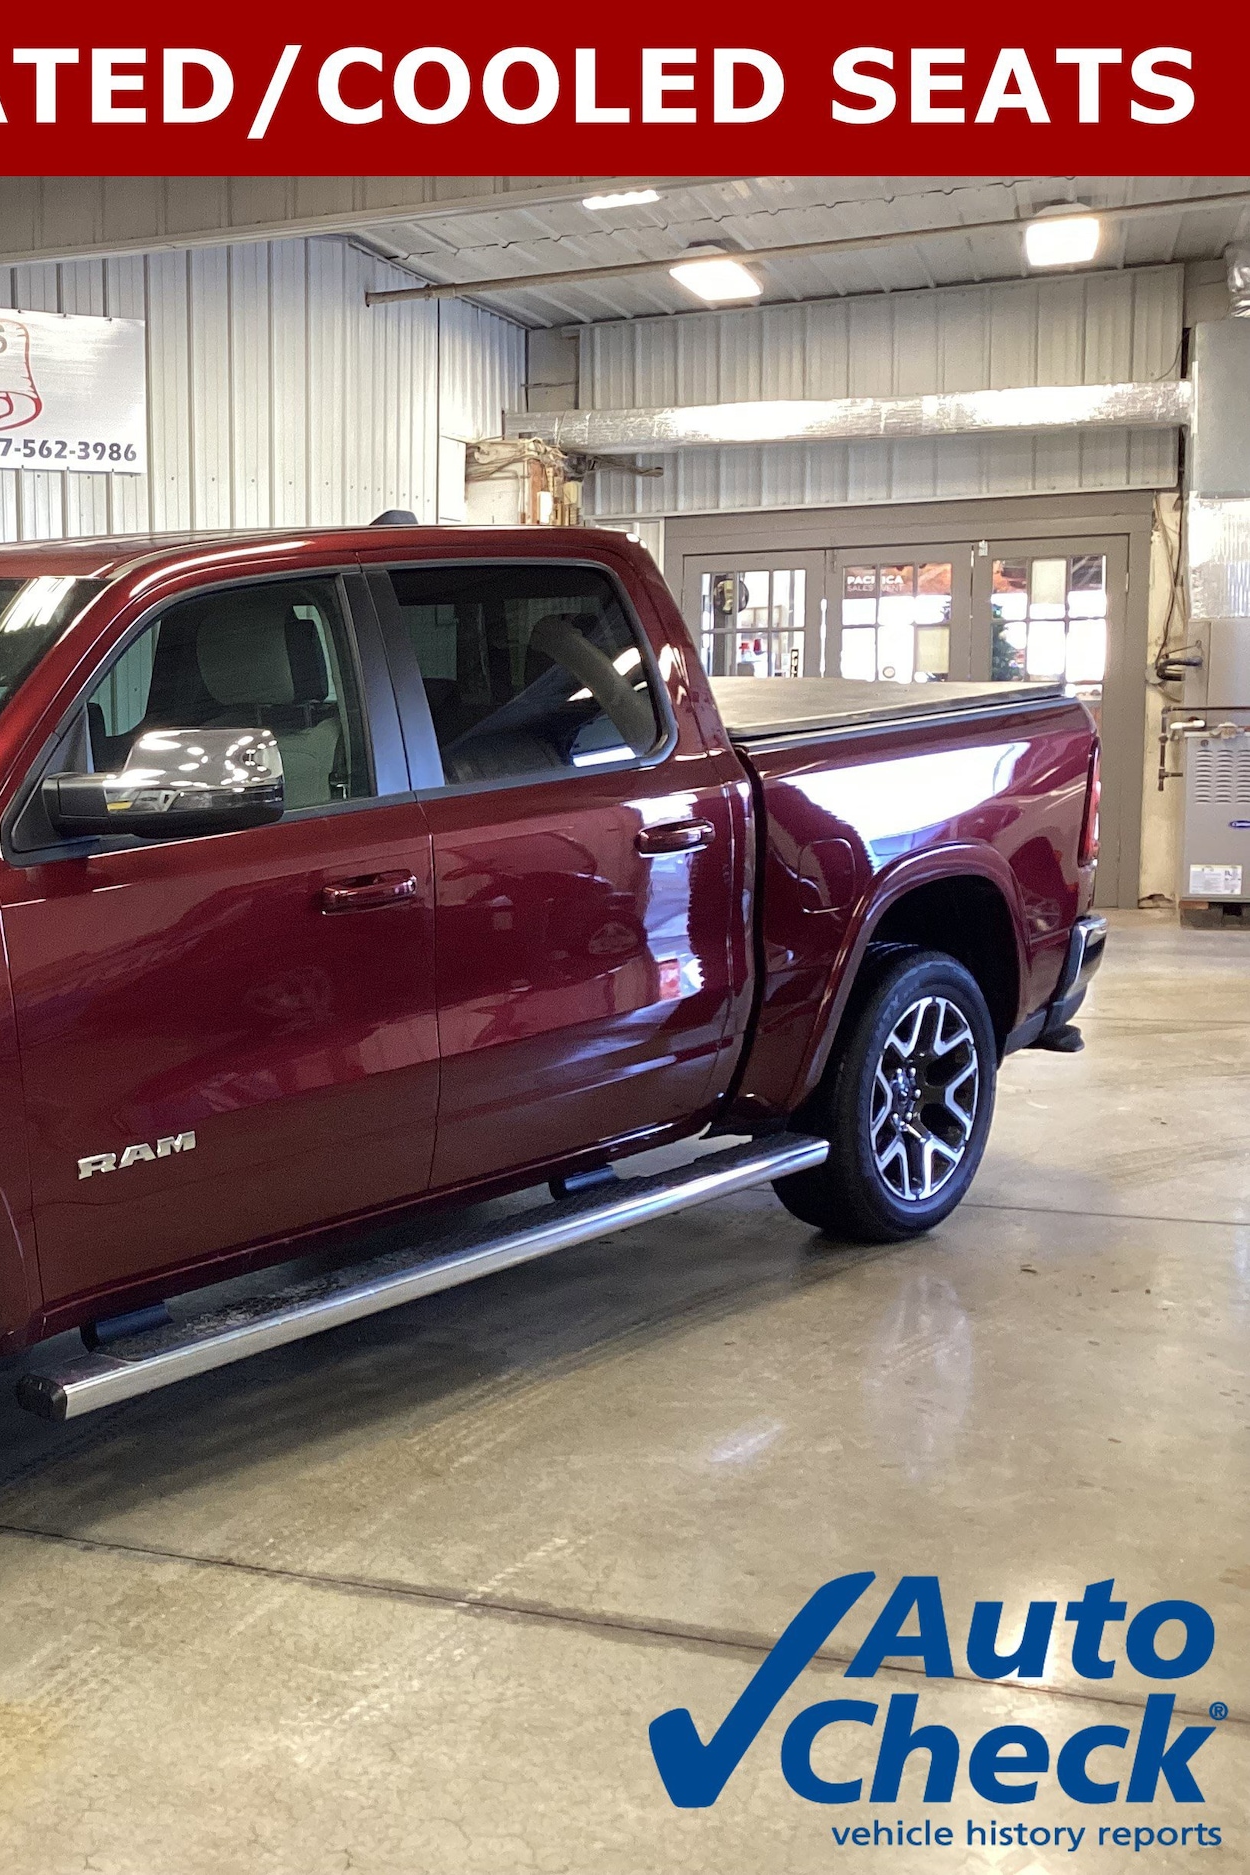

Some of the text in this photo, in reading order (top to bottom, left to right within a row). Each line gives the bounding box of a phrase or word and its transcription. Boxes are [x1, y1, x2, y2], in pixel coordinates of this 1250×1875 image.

[846, 574, 905, 585] PACIICA
[876, 583, 904, 592] VENT
[77, 1130, 196, 1180] RAM
